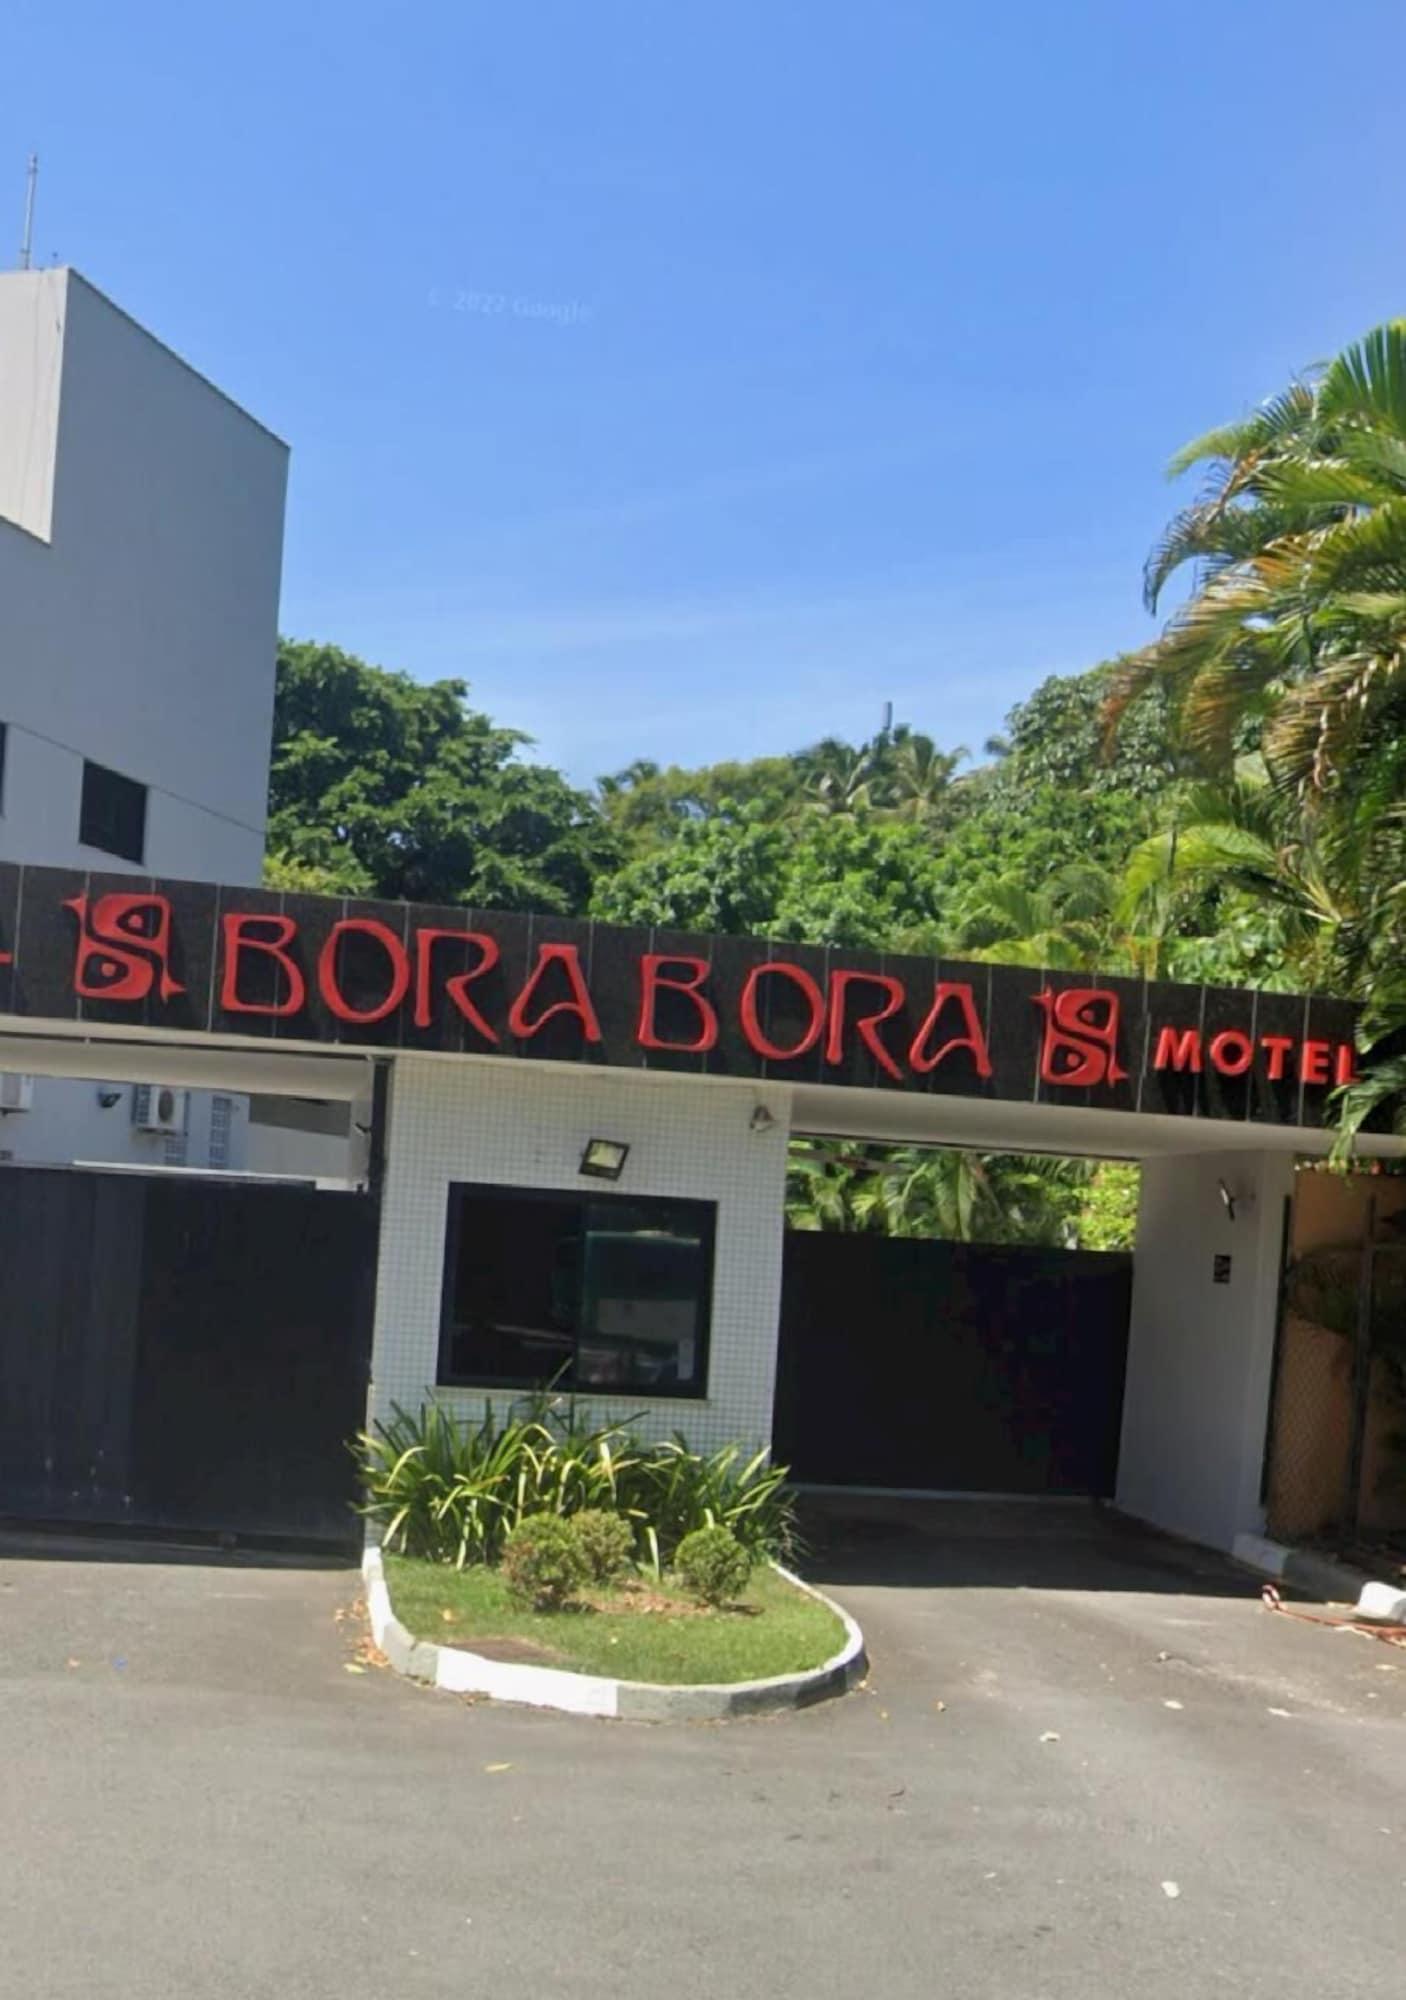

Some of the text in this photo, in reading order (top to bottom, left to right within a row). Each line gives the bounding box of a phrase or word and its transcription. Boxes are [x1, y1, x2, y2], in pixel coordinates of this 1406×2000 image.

[221, 912, 1361, 1085] BORA BORA MOTEL
